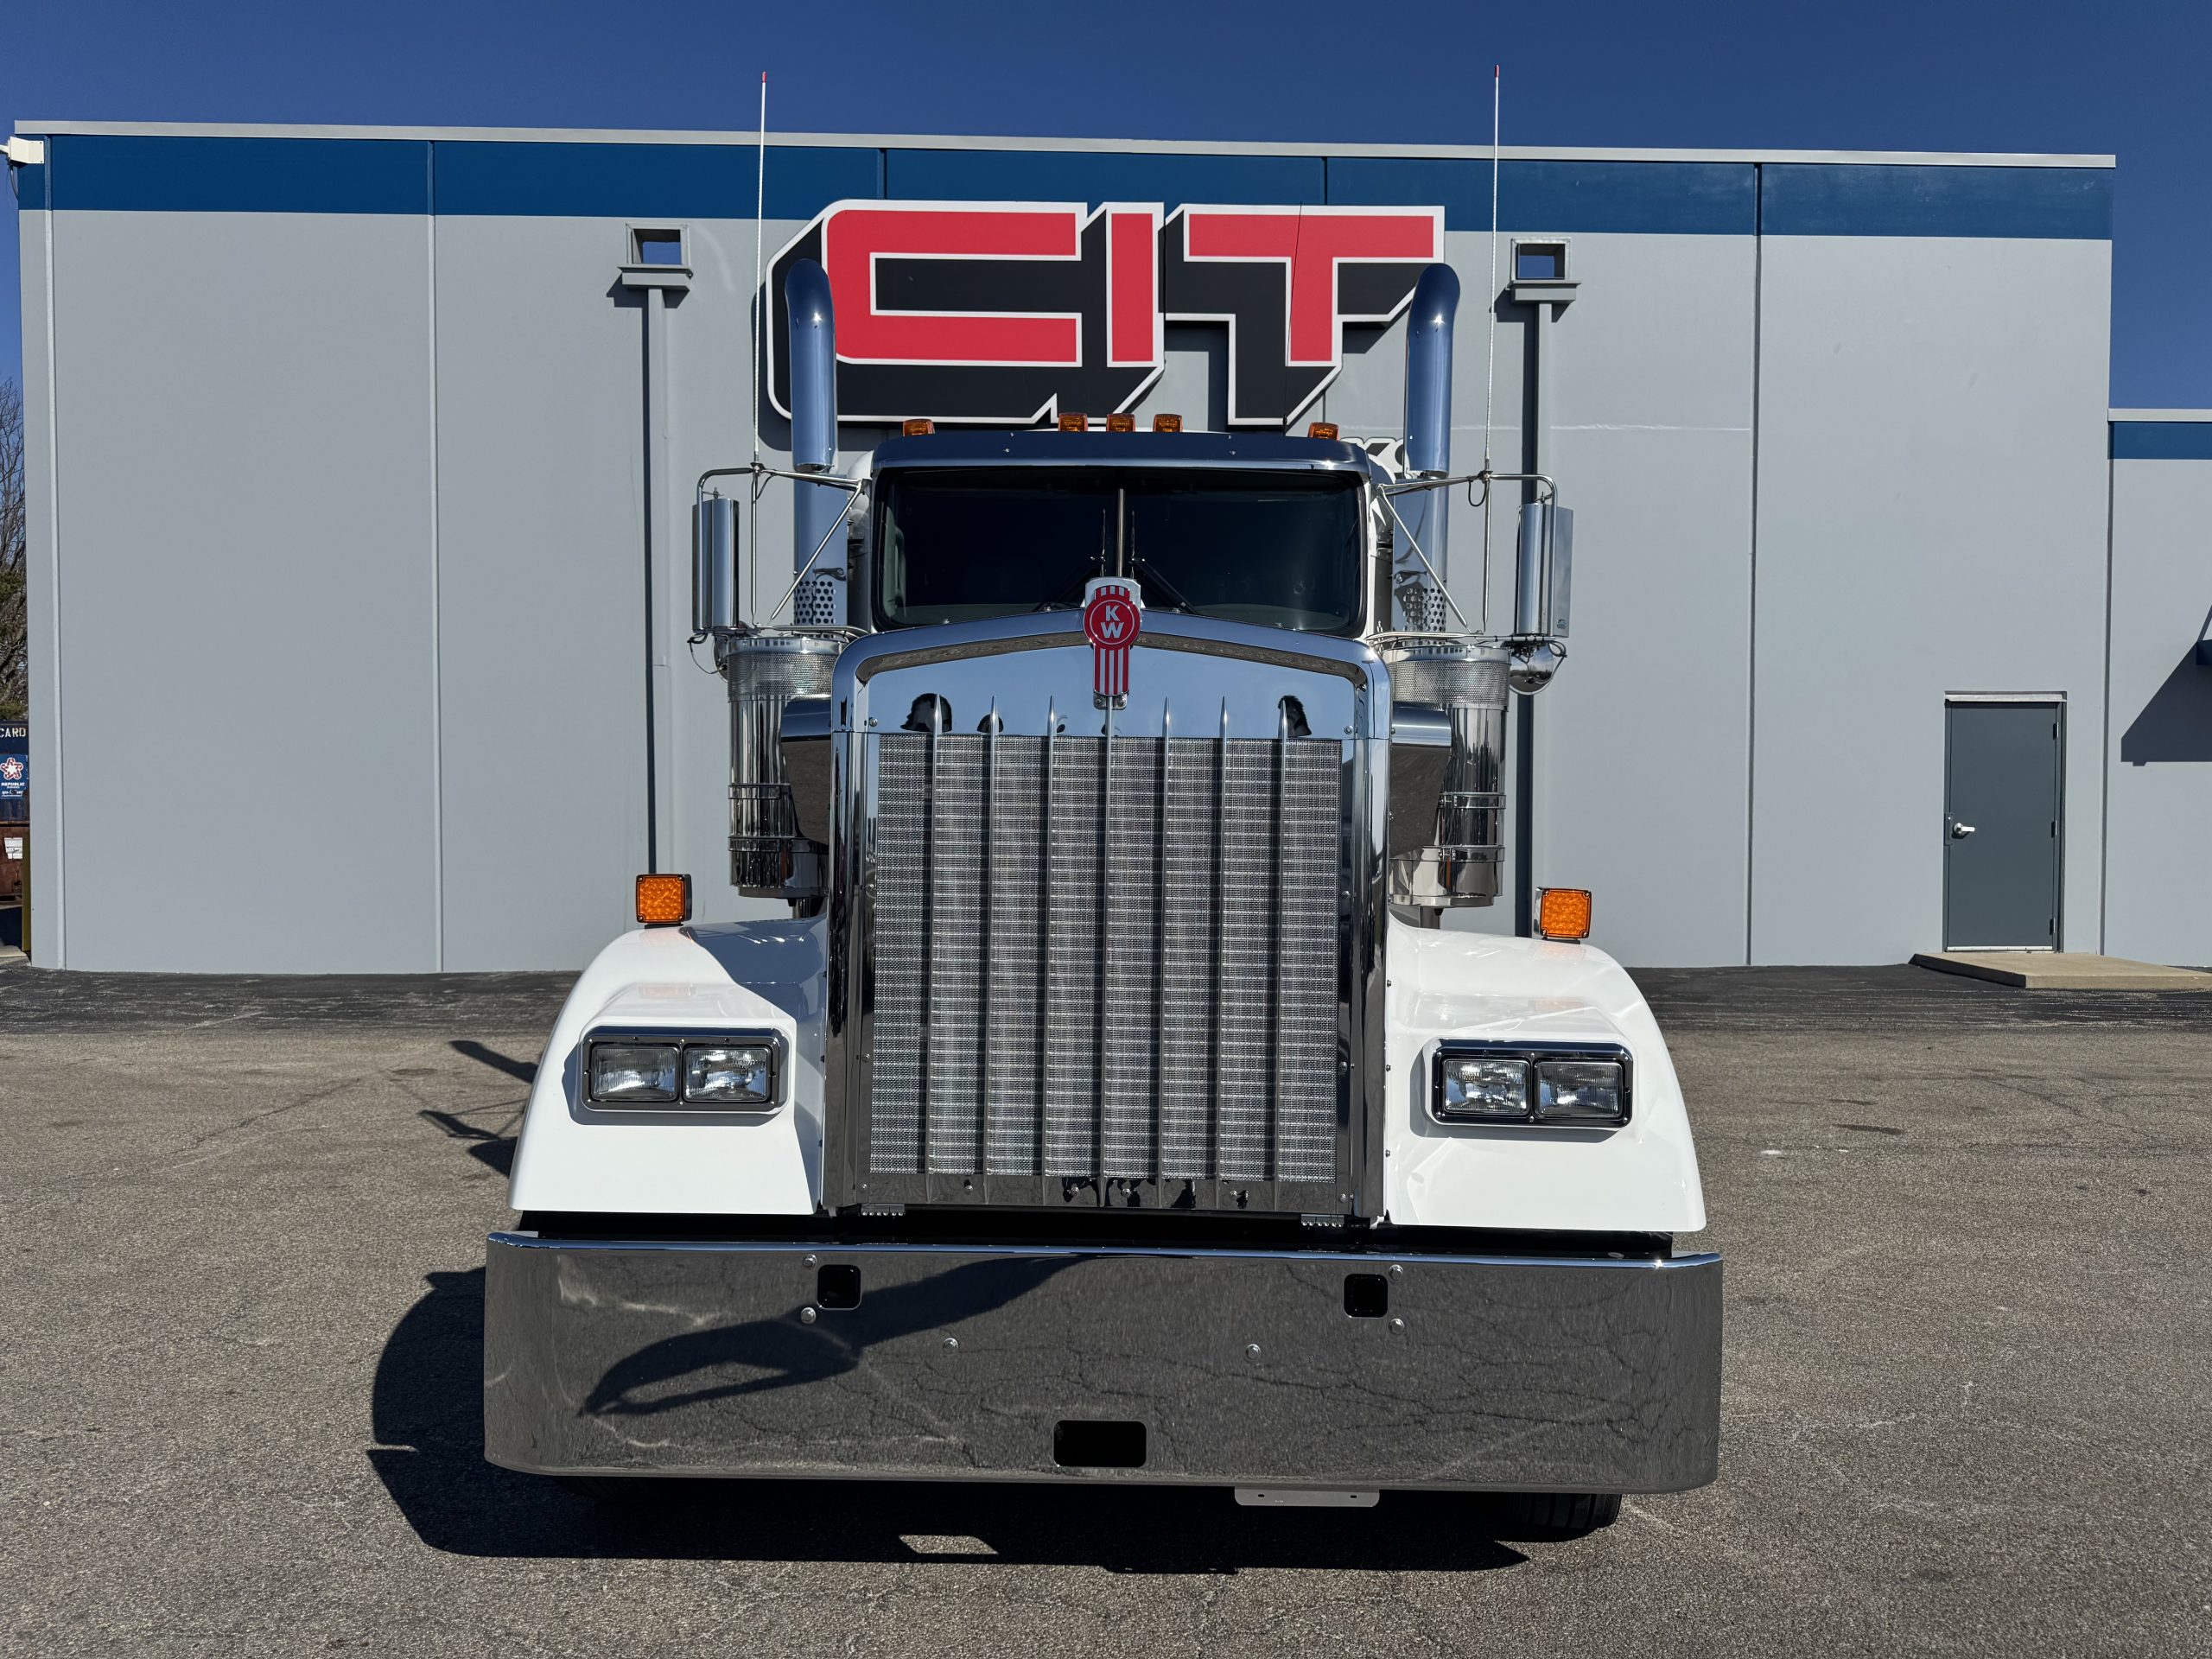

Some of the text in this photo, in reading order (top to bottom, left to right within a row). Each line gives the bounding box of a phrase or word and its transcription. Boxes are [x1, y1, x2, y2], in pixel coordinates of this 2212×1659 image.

[822, 201, 1445, 368] CIT
[1106, 606, 1120, 621] K
[1101, 622, 1124, 639] W
